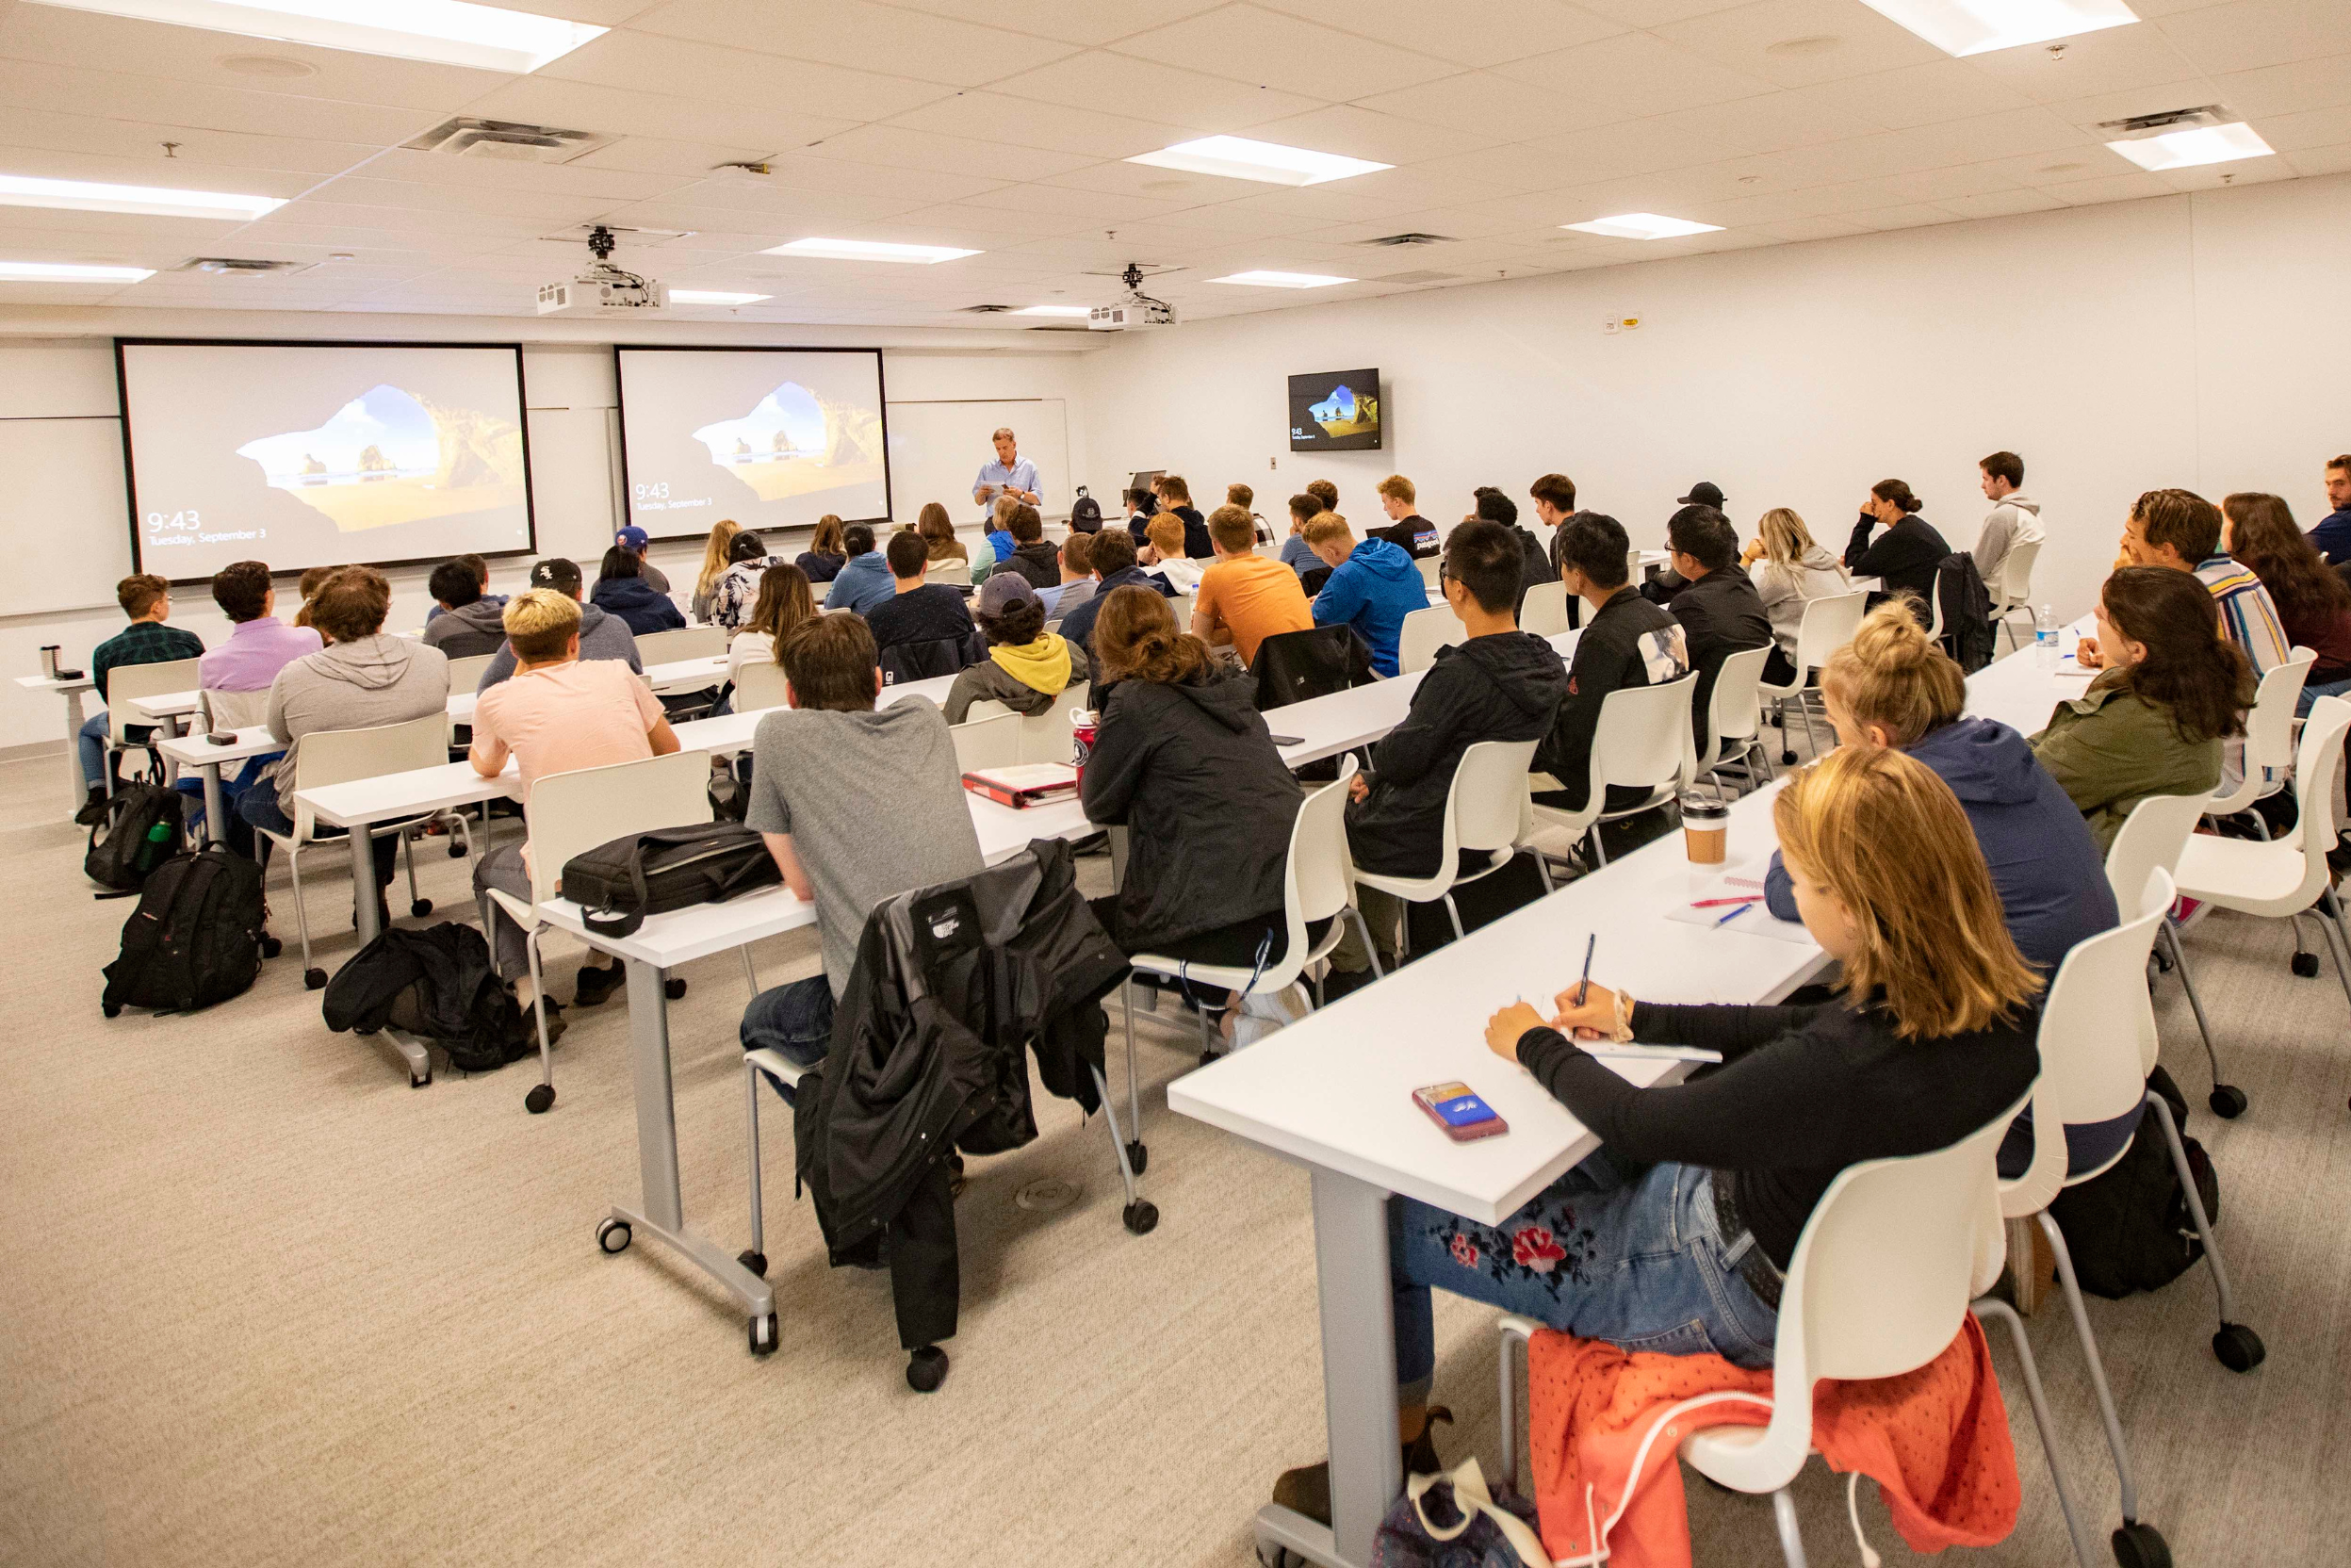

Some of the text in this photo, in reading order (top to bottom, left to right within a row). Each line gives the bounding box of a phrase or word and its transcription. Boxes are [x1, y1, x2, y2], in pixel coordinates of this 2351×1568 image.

[635, 482, 670, 500] 9:43
[637, 497, 712, 511] Tuesday, September 3
[147, 510, 202, 533] 9:43
[198, 530, 257, 544] September
[259, 528, 267, 539] 3
[1416, 537, 1440, 550] patagoni
